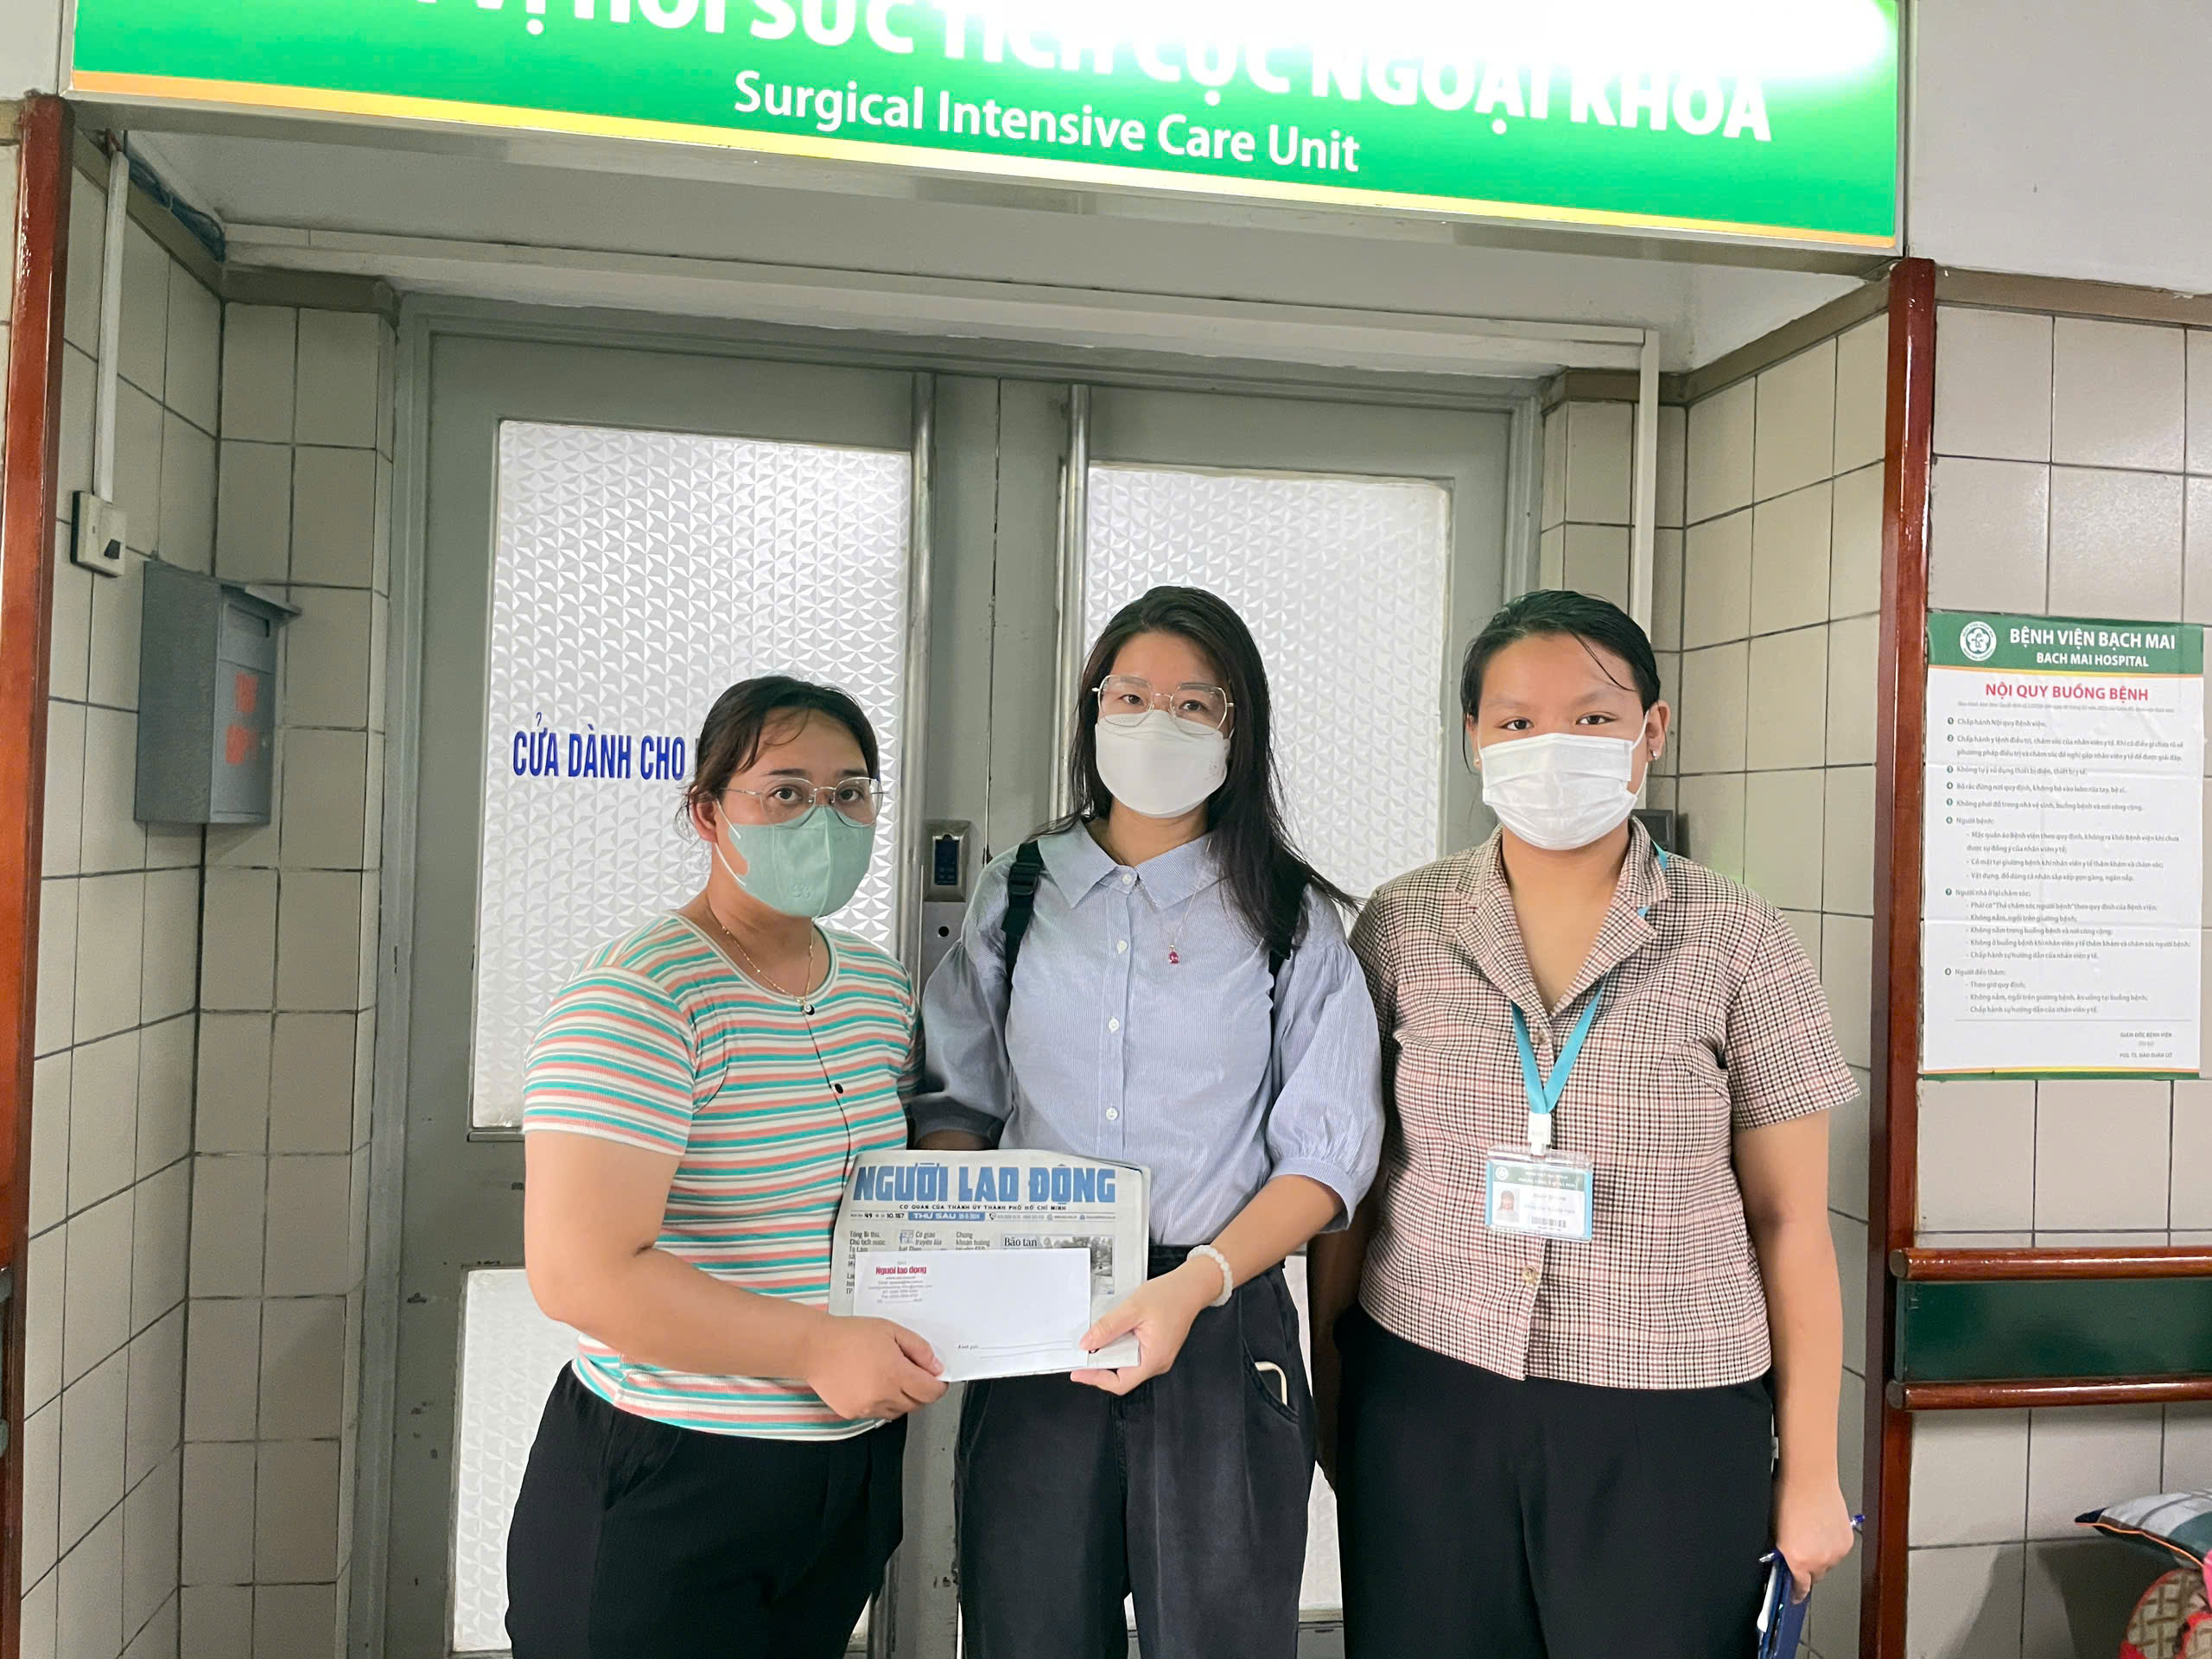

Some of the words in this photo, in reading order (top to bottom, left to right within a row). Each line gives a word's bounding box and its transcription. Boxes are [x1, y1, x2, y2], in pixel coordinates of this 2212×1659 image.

[1569, 62, 1772, 142] KHOA
[734, 70, 924, 132] Surgical
[939, 90, 1146, 151] Intensive
[1158, 113, 1255, 162] Care
[1268, 124, 1360, 172] Unit
[2010, 626, 2054, 647] BỆNH
[2057, 628, 2094, 650] VIỆN
[2099, 631, 2141, 651] BẠCH
[2145, 634, 2176, 649] MAI
[2037, 652, 2068, 664] BACH
[2070, 654, 2092, 665] MAI
[2094, 655, 2149, 667] HOSPITAL
[1986, 682, 2012, 699] NỘI
[2016, 685, 2048, 698] QUY
[2109, 686, 2149, 703] BỆNH
[512, 711, 559, 777] CỬA
[568, 723, 632, 779] DÀNH
[640, 735, 685, 781] CHO
[958, 1166, 1020, 1202] LAO
[1028, 1163, 1116, 1205] ĐỘNG
[1022, 1238, 1038, 1247] tan
